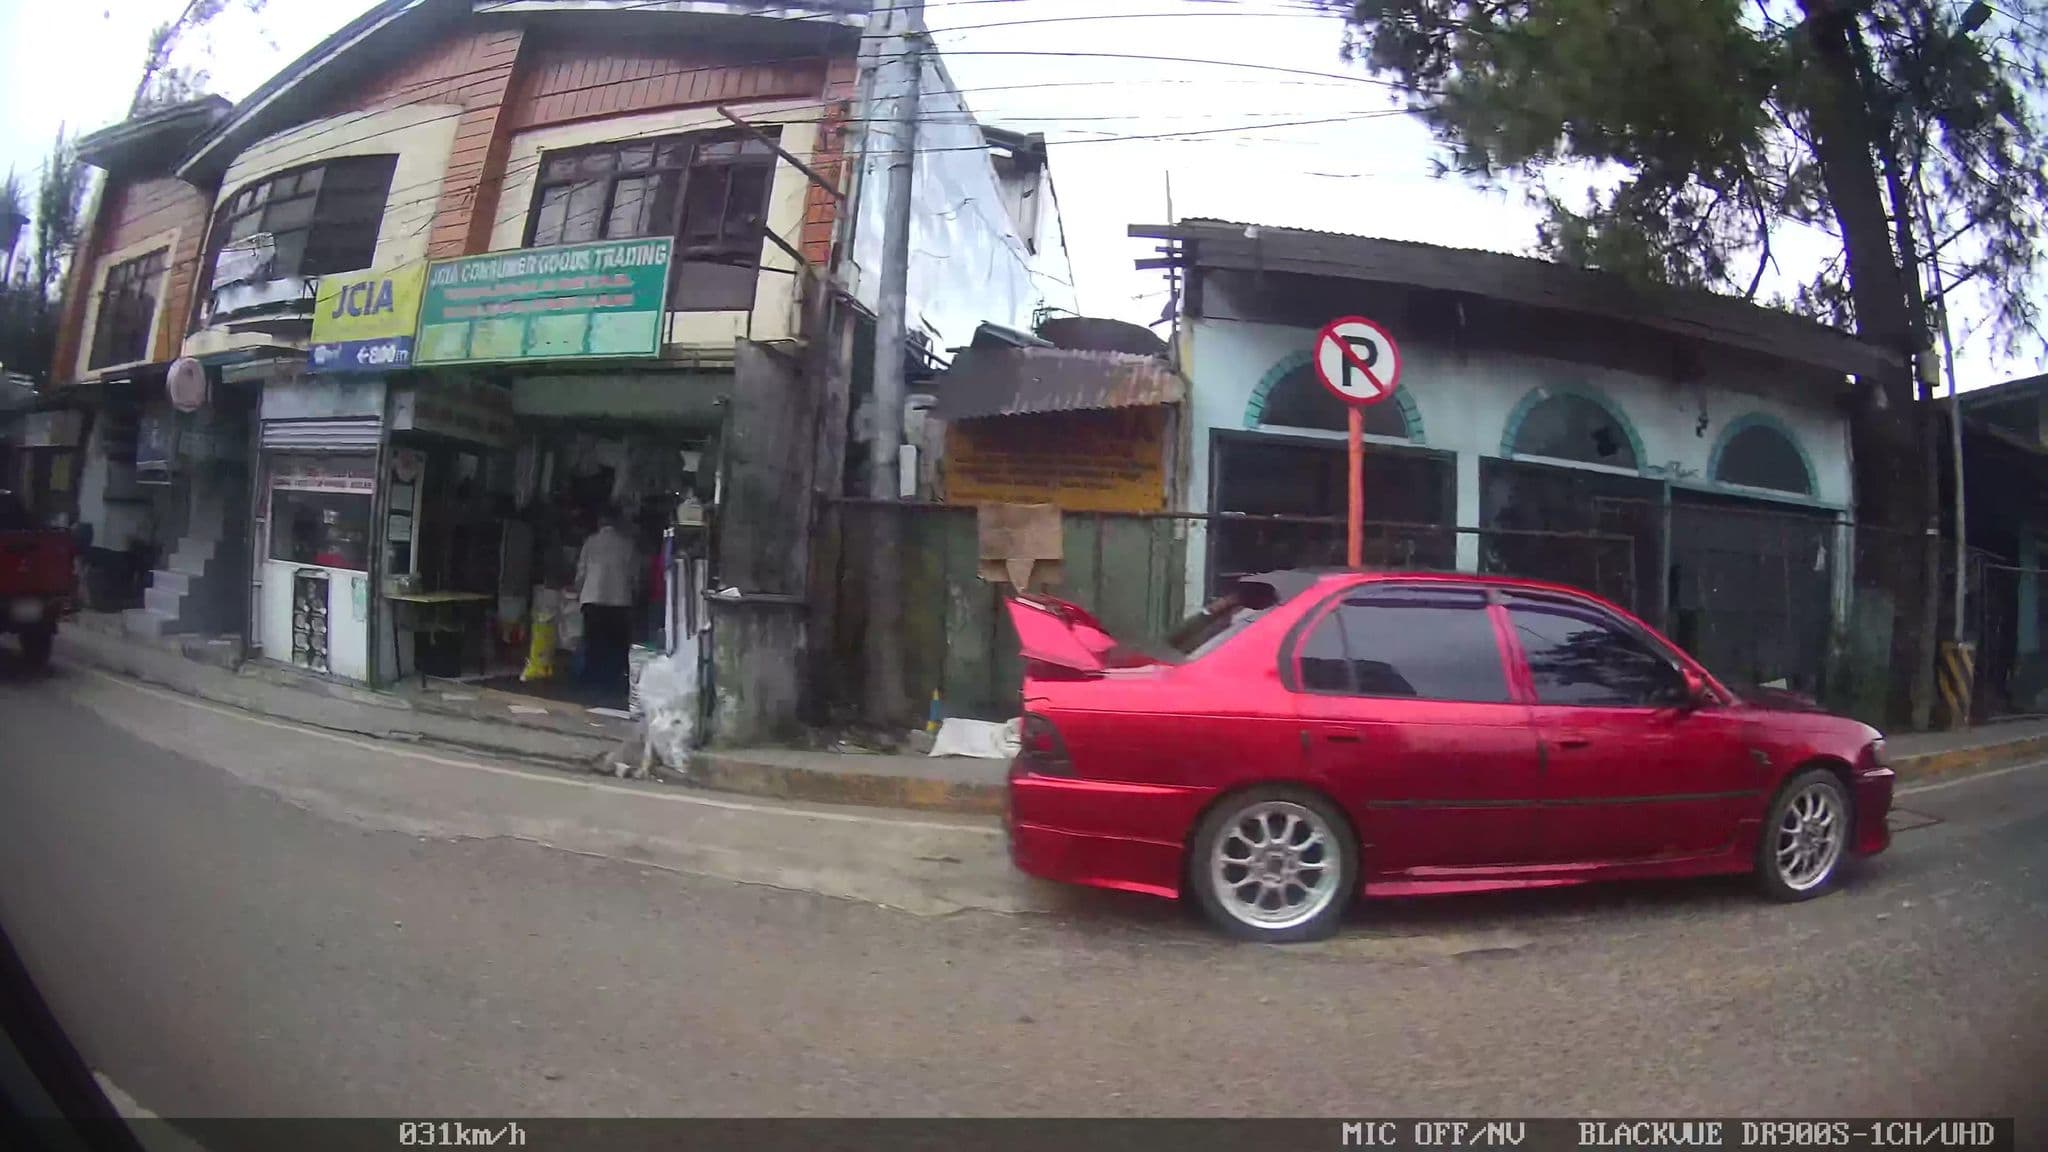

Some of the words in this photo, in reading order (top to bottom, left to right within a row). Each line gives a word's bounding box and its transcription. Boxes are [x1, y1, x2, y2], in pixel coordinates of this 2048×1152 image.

[594, 244, 667, 272] TRADING
[332, 279, 394, 319] JCIA
[1341, 335, 1378, 387] P
